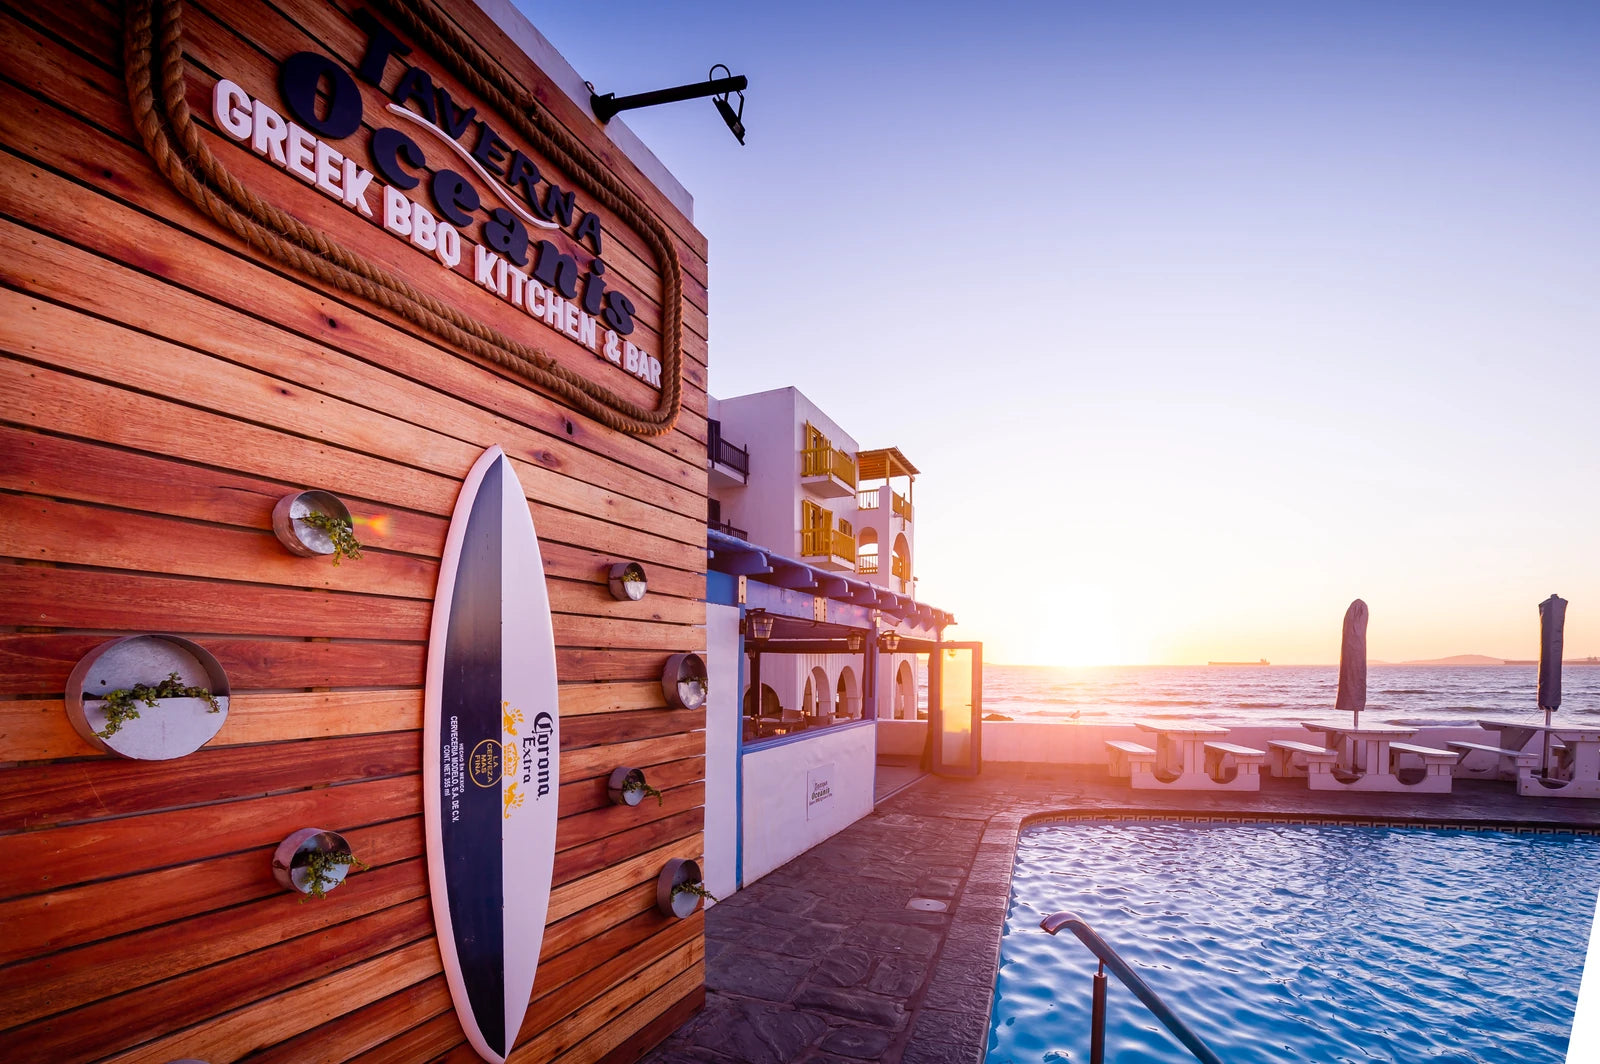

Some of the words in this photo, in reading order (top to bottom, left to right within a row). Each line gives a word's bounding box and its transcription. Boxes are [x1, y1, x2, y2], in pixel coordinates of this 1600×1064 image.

[352, 8, 603, 255] TAVERNA
[278, 50, 635, 336] Oceanis
[212, 78, 374, 218] GREEK
[383, 184, 462, 269] BBQ
[474, 244, 598, 351] KITCHEN
[602, 329, 622, 367] &
[625, 341, 663, 389] BAR
[450, 715, 458, 756] CERVECERIA
[443, 744, 451, 763] CONT.
[493, 755, 499, 768] LA
[522, 736, 536, 784] Extra
[532, 711, 554, 798] Corona
[443, 764, 451, 777] NET.
[444, 788, 451, 796] ml
[452, 801, 459, 810] DE
[452, 810, 460, 823] C.V.
